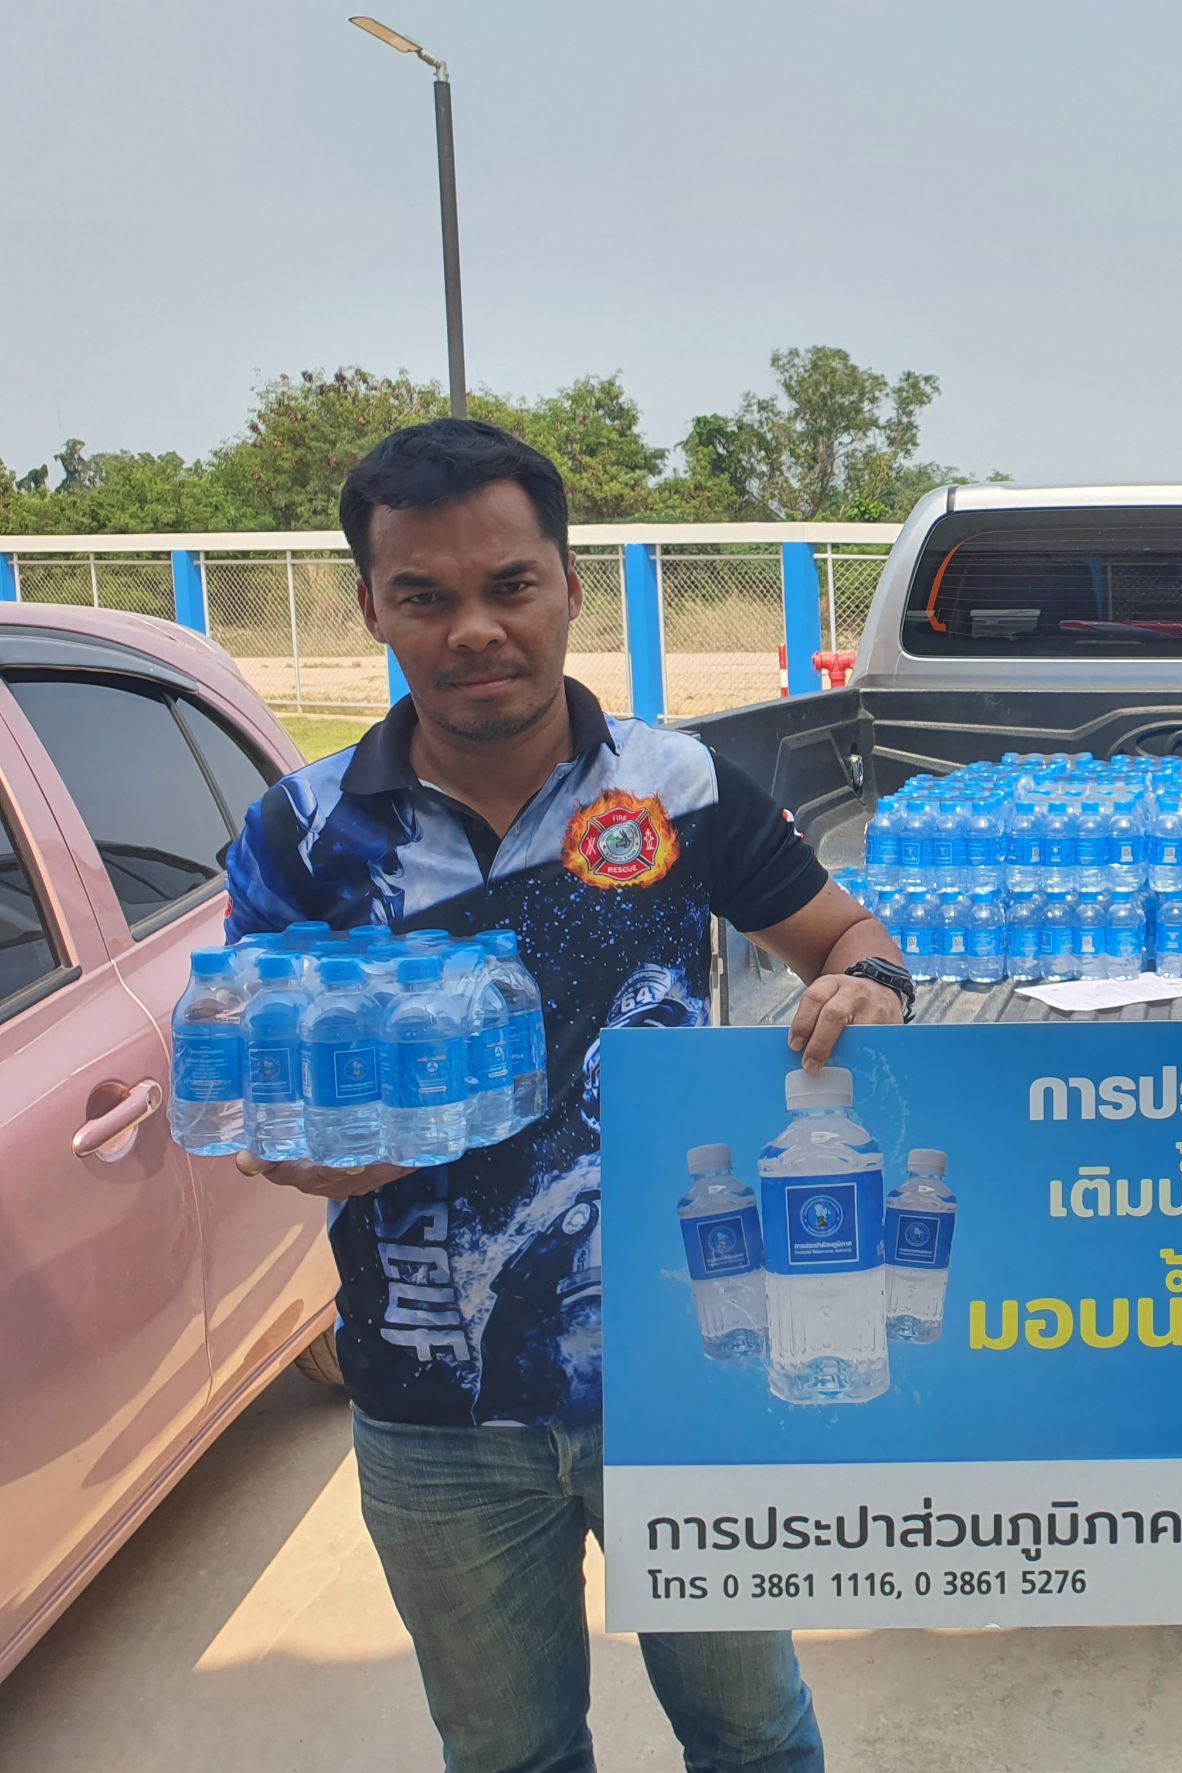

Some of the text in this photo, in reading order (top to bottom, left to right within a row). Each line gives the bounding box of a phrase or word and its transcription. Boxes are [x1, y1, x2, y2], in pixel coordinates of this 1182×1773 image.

[612, 814, 627, 822] FIRE
[607, 865, 638, 873] RESCUE
[647, 1568, 1087, 1600] โทร 0 3861 1116, 0 3861 5276
